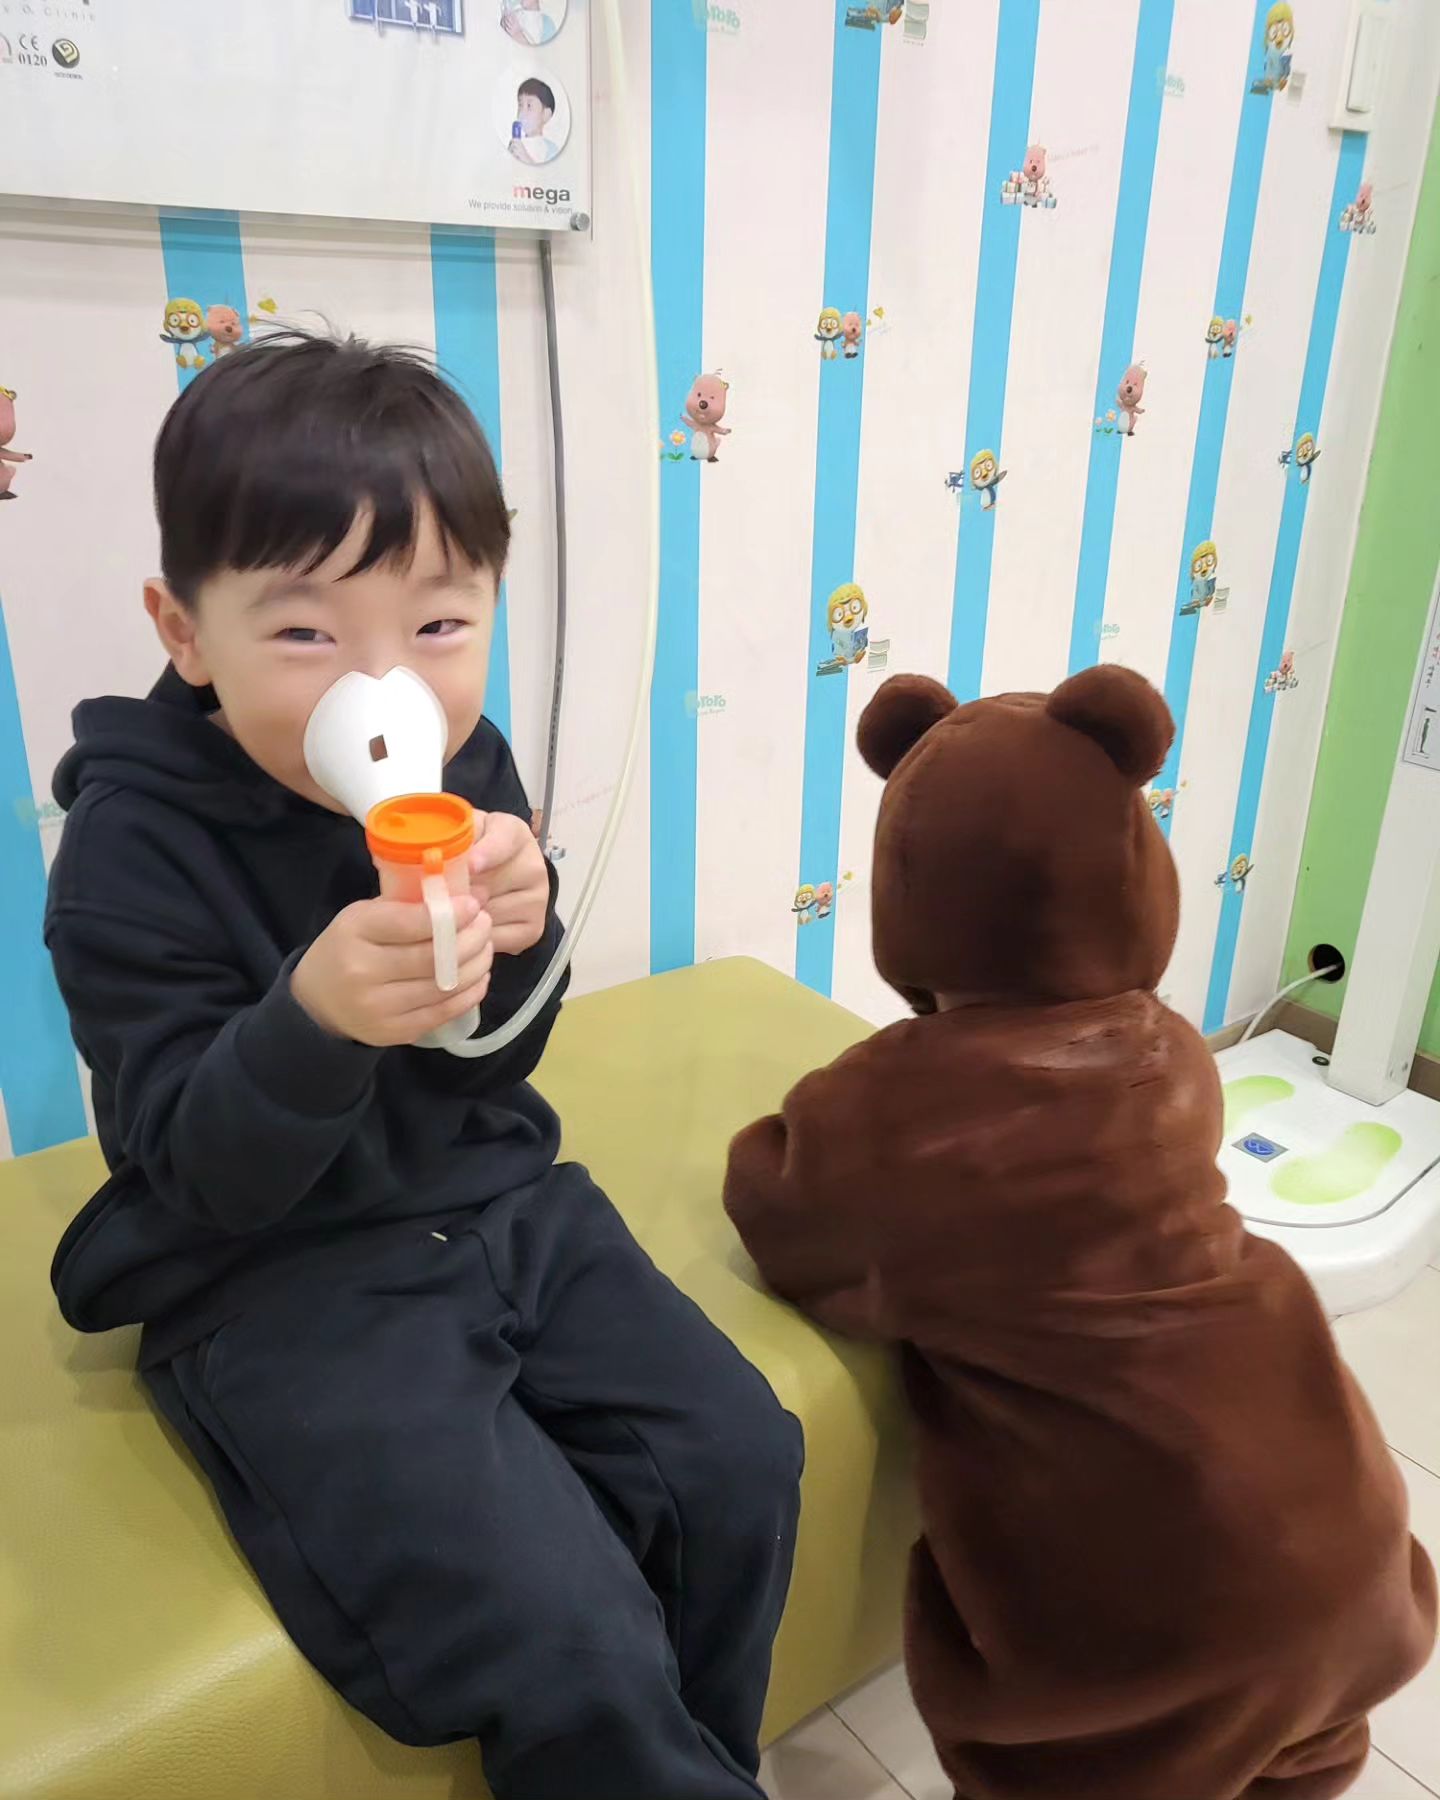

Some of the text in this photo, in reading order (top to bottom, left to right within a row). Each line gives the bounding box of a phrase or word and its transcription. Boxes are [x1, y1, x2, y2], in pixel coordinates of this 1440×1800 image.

[18, 53, 47, 67] 0120
[513, 185, 571, 205] mega
[468, 199, 481, 209] We
[484, 201, 512, 212] provide
